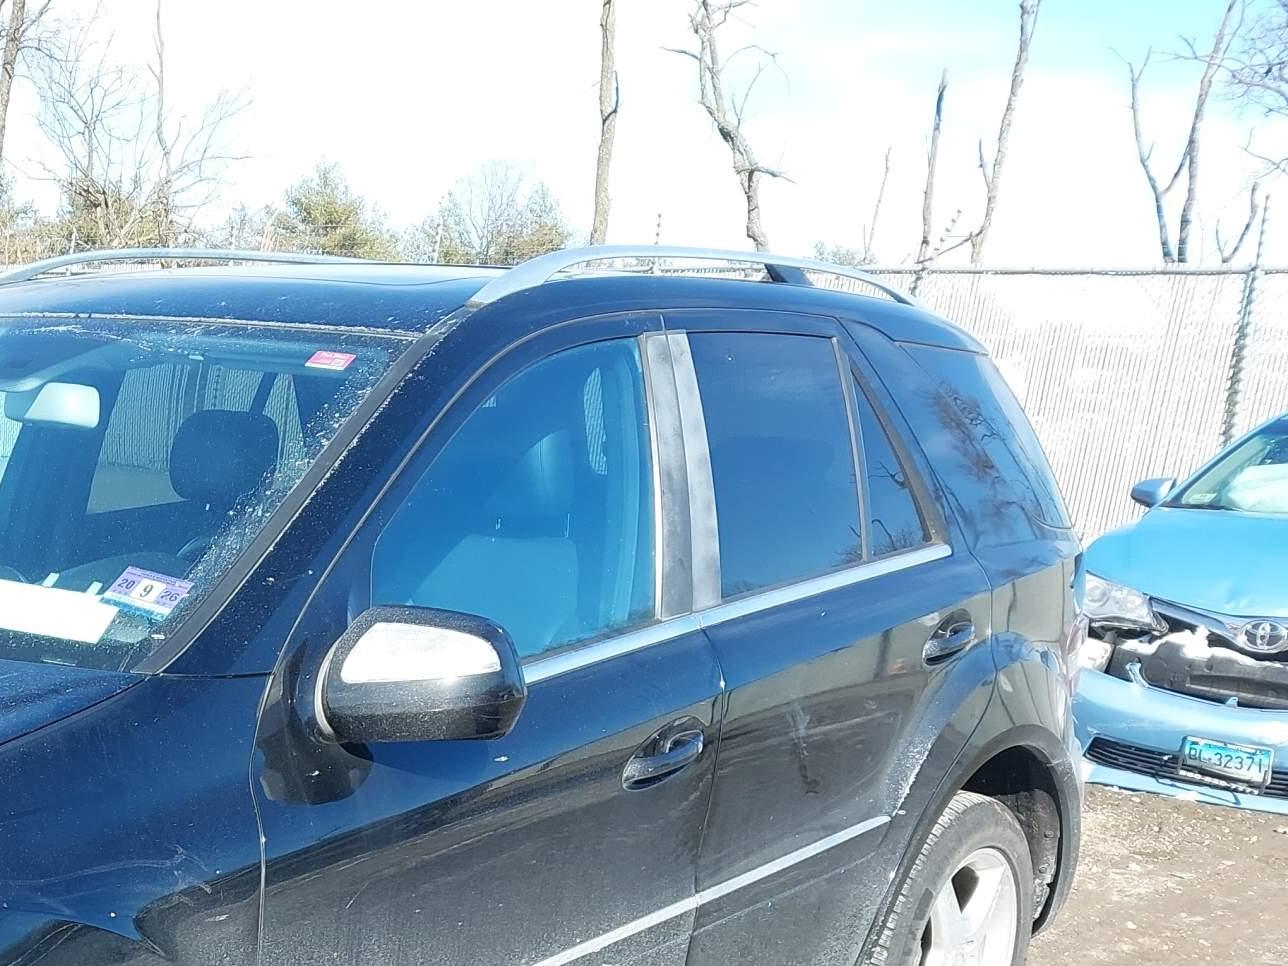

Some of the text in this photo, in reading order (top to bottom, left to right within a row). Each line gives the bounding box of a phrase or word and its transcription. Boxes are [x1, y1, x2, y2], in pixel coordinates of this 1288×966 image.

[118, 578, 136, 590] 20
[139, 584, 154, 598] 9
[159, 590, 180, 602] 26
